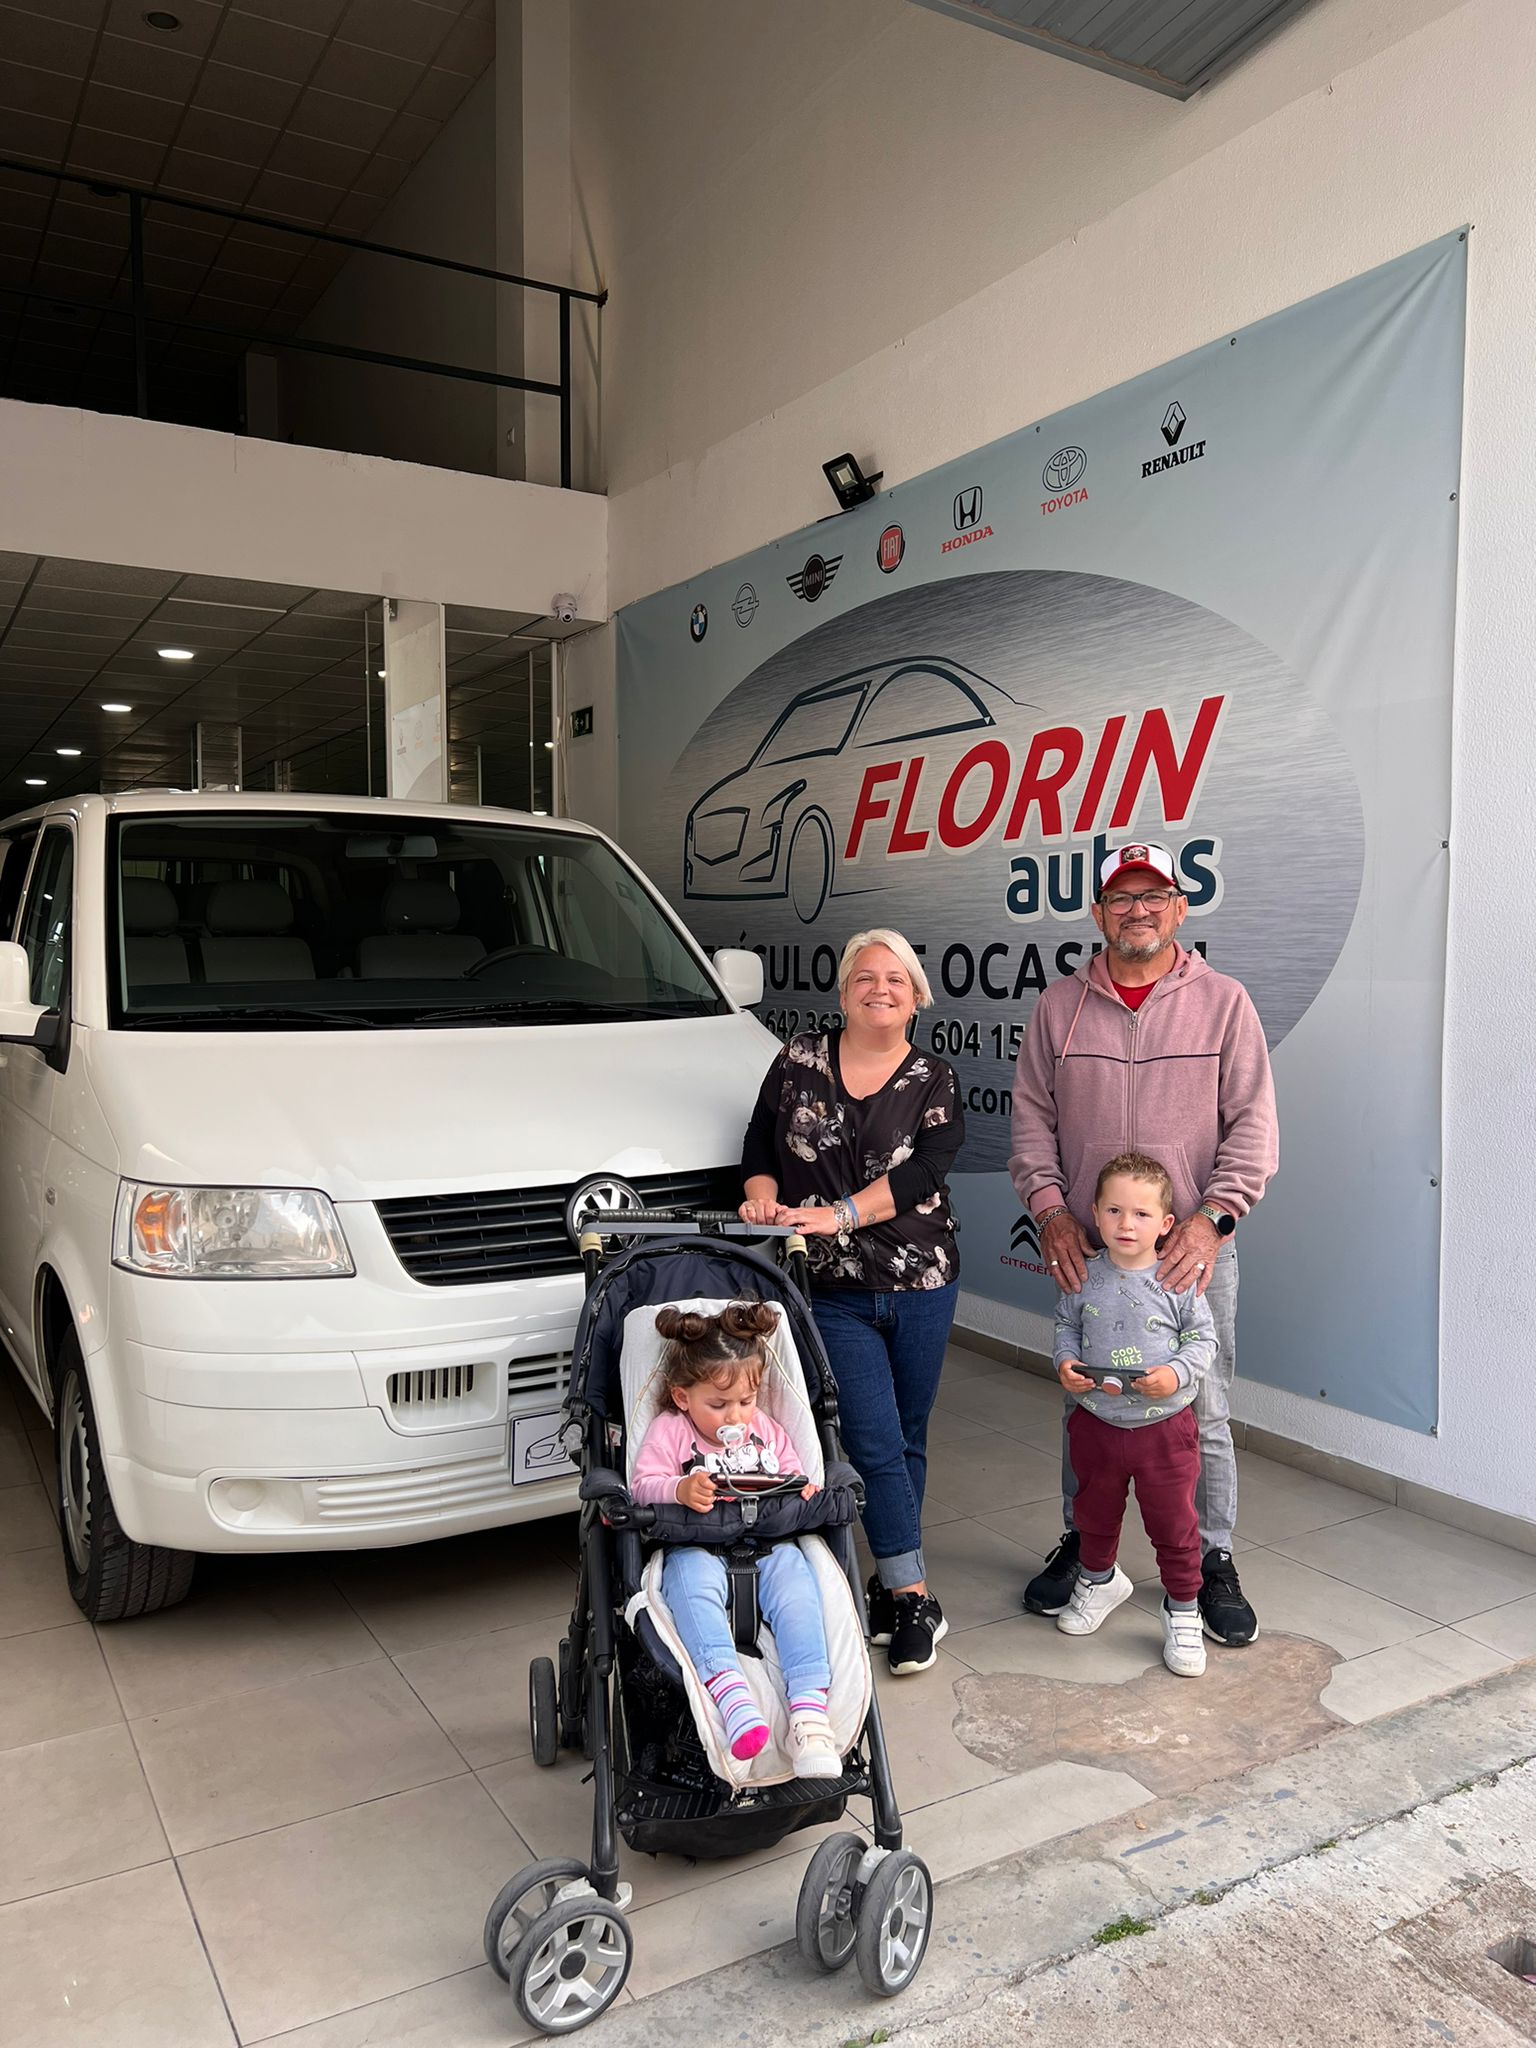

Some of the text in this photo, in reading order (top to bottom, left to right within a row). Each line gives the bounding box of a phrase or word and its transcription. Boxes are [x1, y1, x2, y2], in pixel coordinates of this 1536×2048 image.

[1141, 440, 1206, 478] RENAULT
[1040, 488, 1089, 515] TOYOTA
[884, 535, 900, 561] FIAT
[941, 525, 994, 553] HONDA
[805, 569, 823, 587] MINI
[844, 694, 1226, 860] FLORIN
[1005, 832, 1217, 915] auts
[930, 1018, 982, 1059] 604
[1110, 1345, 1141, 1359] COOL
[1111, 1353, 1143, 1368] VIBES
